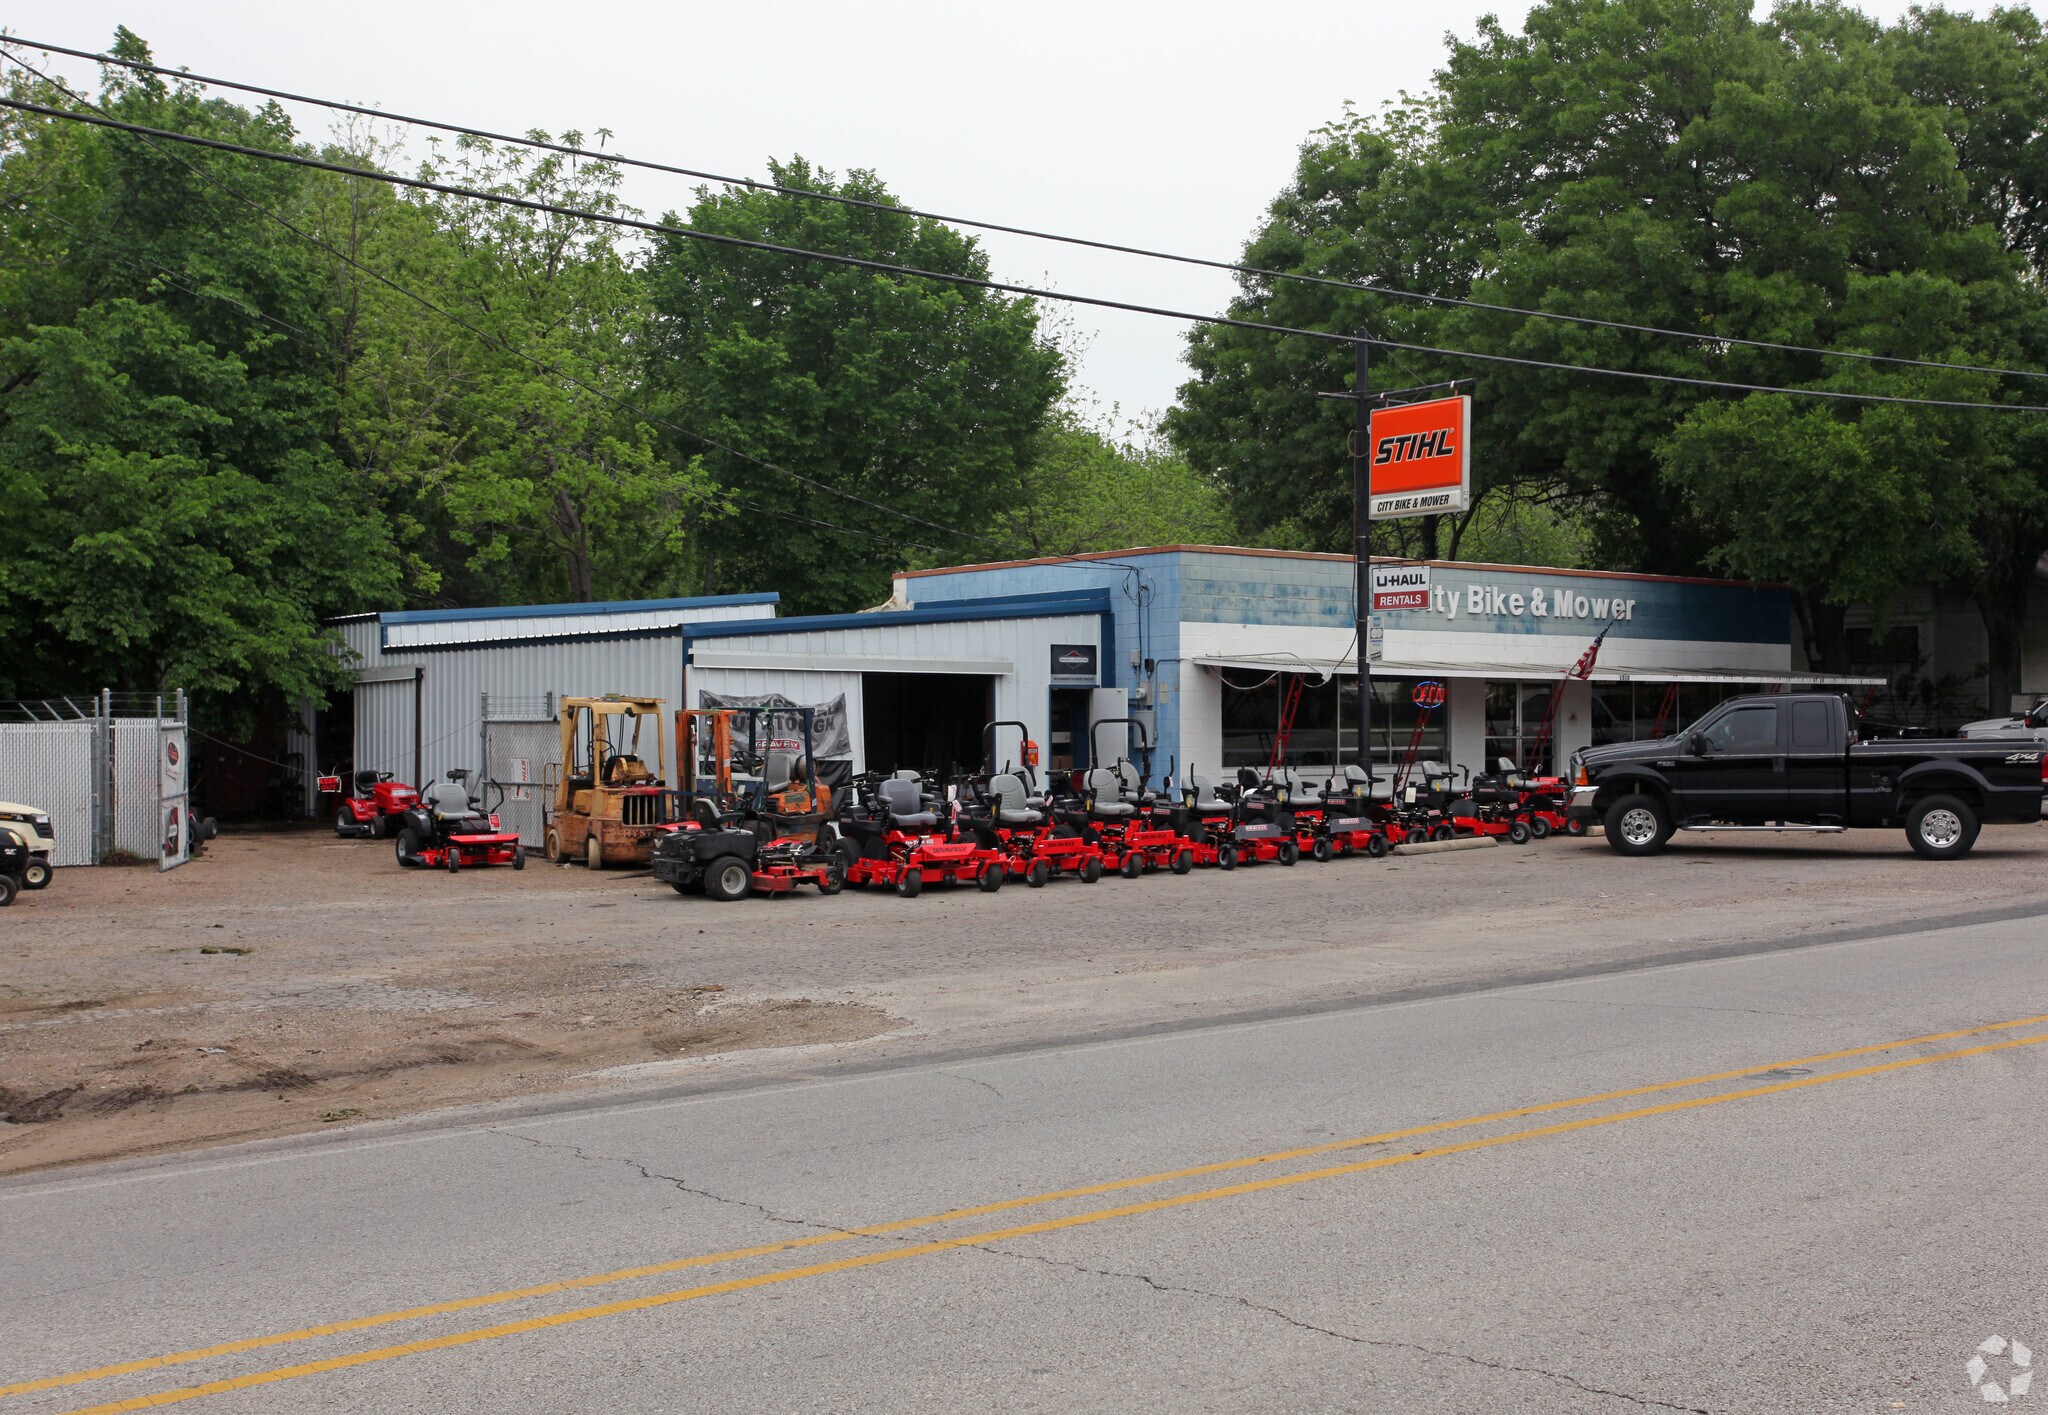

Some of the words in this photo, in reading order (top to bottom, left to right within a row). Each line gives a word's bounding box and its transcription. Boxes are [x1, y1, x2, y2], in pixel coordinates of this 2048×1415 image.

[1374, 428, 1454, 466] STIHL
[1377, 500, 1394, 512] CITY
[1394, 499, 1411, 510] BIKE
[1412, 498, 1419, 508] &
[1419, 494, 1450, 507] MOWER
[1376, 573, 1426, 587] U-HAUL
[1380, 594, 1422, 606] RENTALS
[1467, 585, 1524, 616] Bike
[1530, 588, 1548, 617] &
[1553, 590, 1636, 621] Mower
[1413, 686, 1447, 703] OPEN
